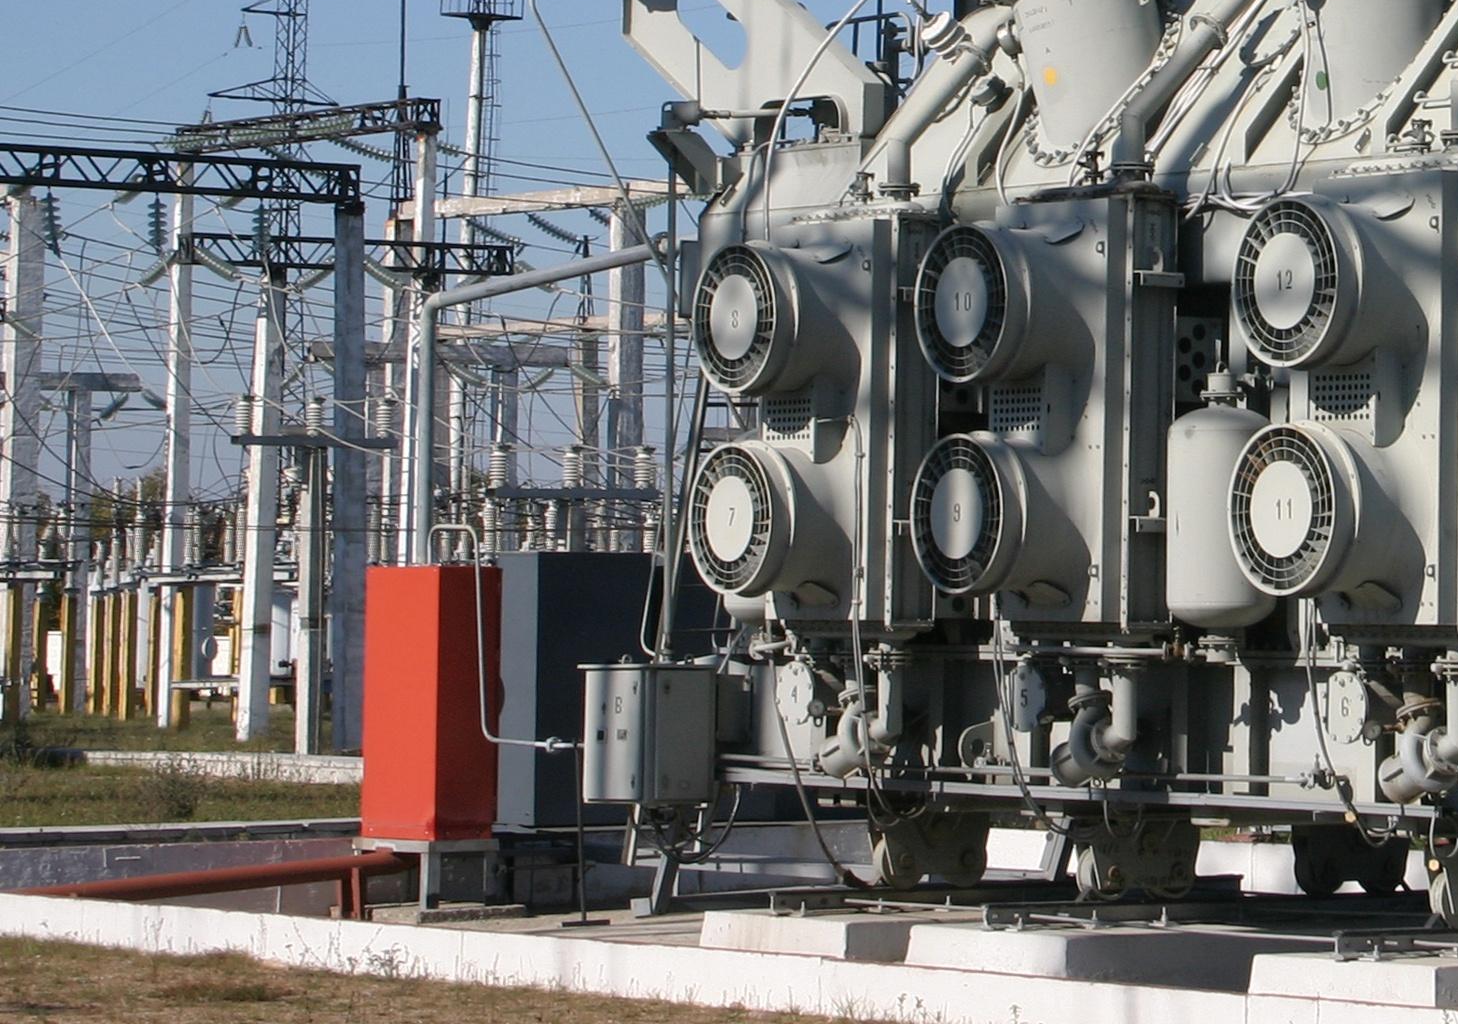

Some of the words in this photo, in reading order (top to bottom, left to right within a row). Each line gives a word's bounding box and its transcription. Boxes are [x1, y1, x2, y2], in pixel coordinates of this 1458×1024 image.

[1276, 269, 1293, 291] 12
[955, 291, 972, 312] 10
[731, 309, 739, 329] 8
[728, 507, 736, 527] 7
[953, 503, 961, 523] 9
[1276, 497, 1292, 521] 11
[790, 685, 798, 704] 4
[1020, 688, 1028, 708] 5
[1341, 695, 1349, 717] 6
